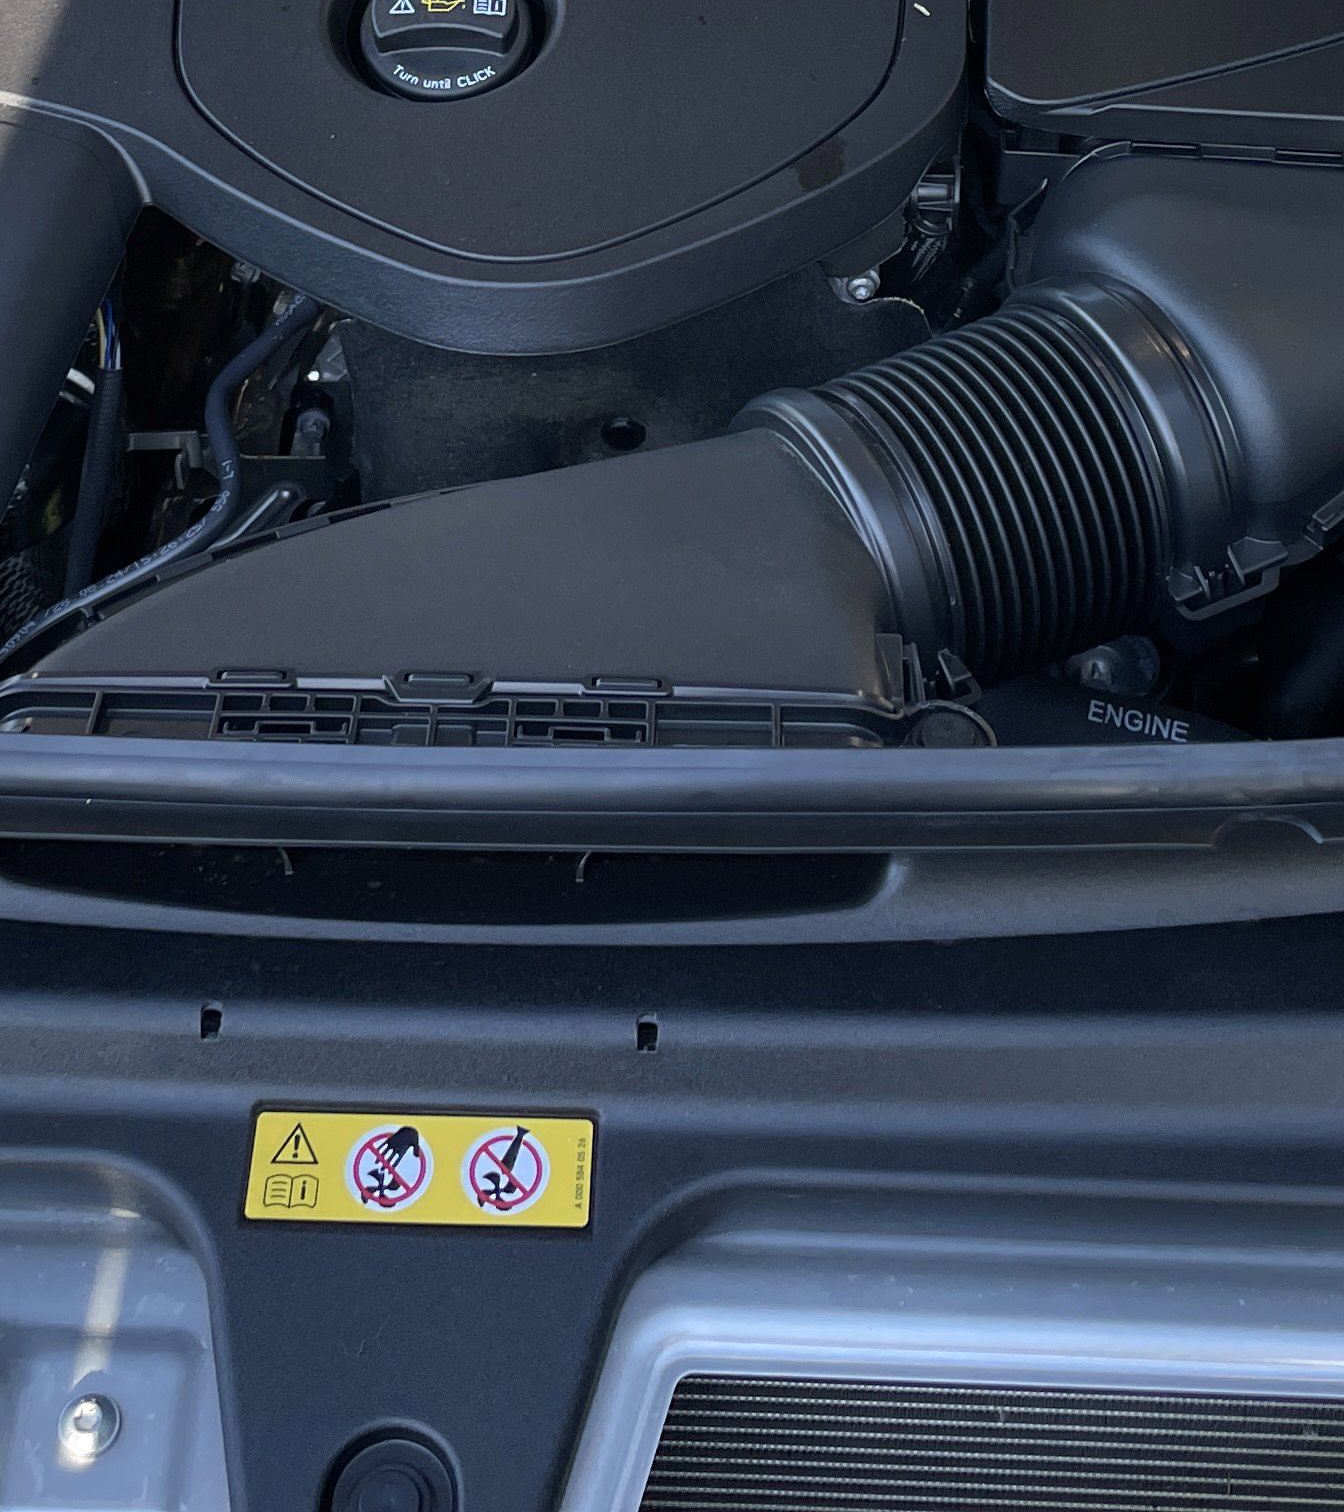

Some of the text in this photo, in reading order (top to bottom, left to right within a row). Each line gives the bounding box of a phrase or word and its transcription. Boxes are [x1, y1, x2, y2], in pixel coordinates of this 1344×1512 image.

[392, 63, 498, 90] Turn until CLICK
[1087, 698, 1190, 744] ENGINE
